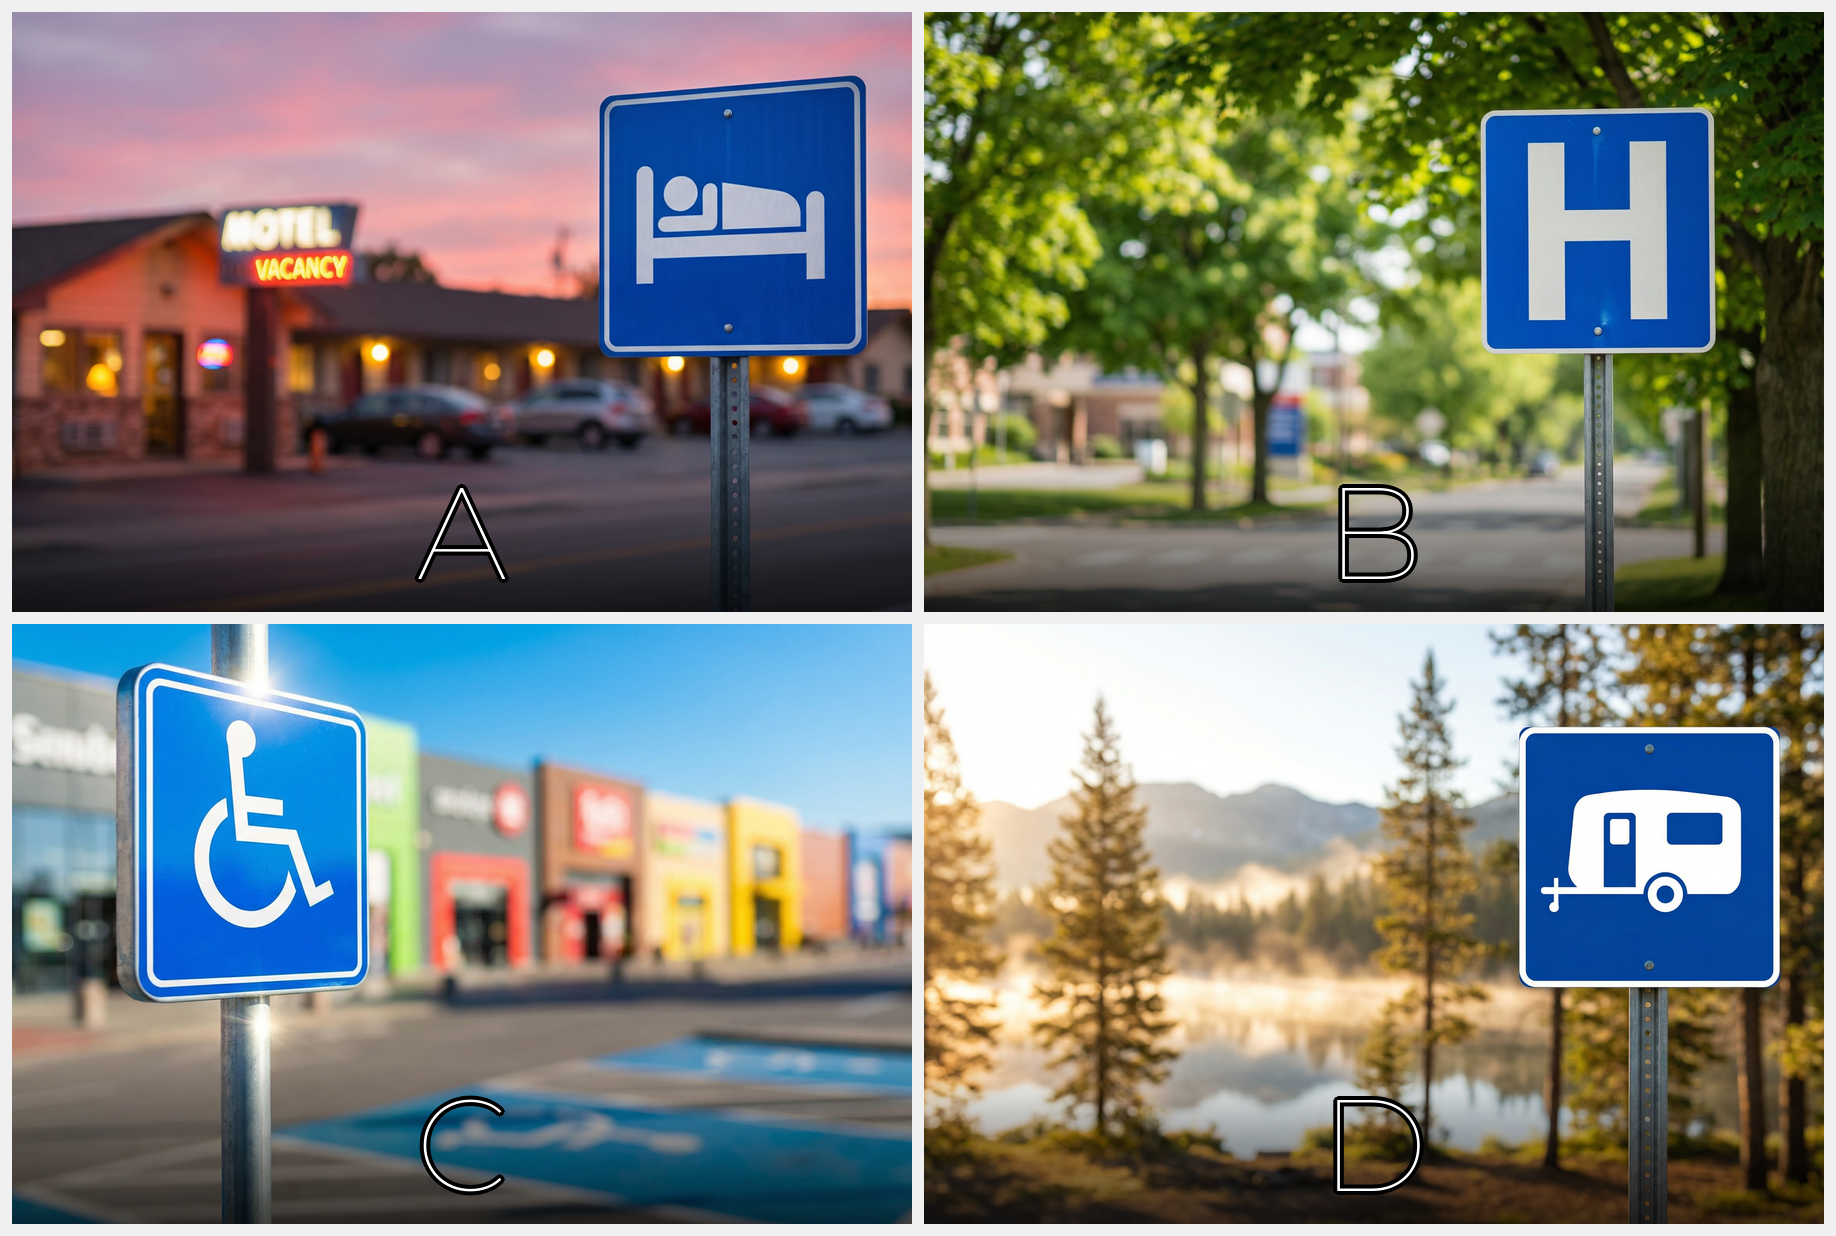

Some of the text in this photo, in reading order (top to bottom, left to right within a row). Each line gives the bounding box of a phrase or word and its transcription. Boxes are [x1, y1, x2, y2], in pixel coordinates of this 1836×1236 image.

[221, 206, 341, 252] MOTEL
[1528, 141, 1667, 320] H
[255, 255, 347, 281] VACANCY
